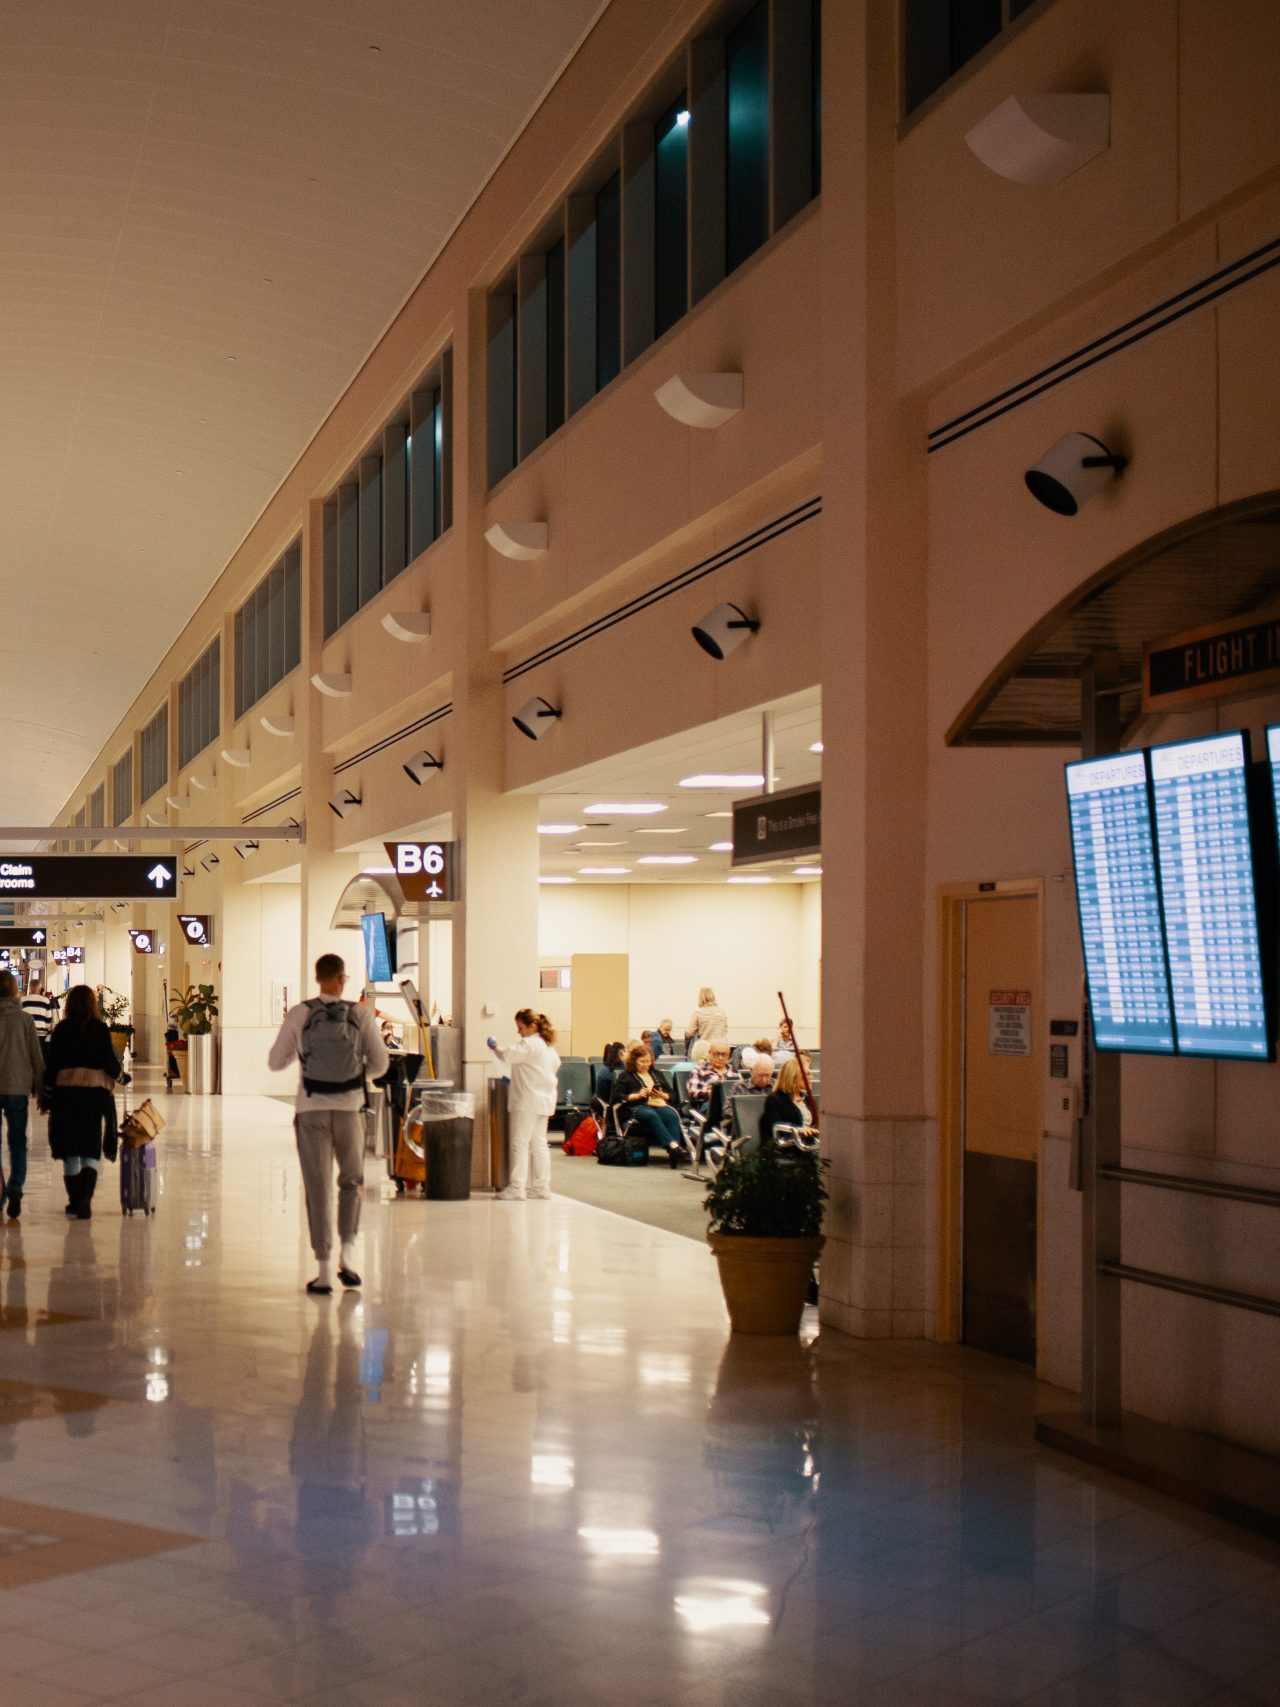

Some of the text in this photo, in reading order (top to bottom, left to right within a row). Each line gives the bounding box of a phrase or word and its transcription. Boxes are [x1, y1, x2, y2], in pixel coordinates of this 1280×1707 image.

[1184, 623, 1280, 681] FLIGHT I
[1177, 747, 1242, 770] DEPARTURES
[1089, 764, 1145, 786] DEPARTURES
[397, 844, 444, 874] B6
[0, 863, 33, 876] Claim
[53, 951, 67, 960] B2
[67, 947, 81, 957] B4
[990, 992, 1015, 1004] SECURITY
